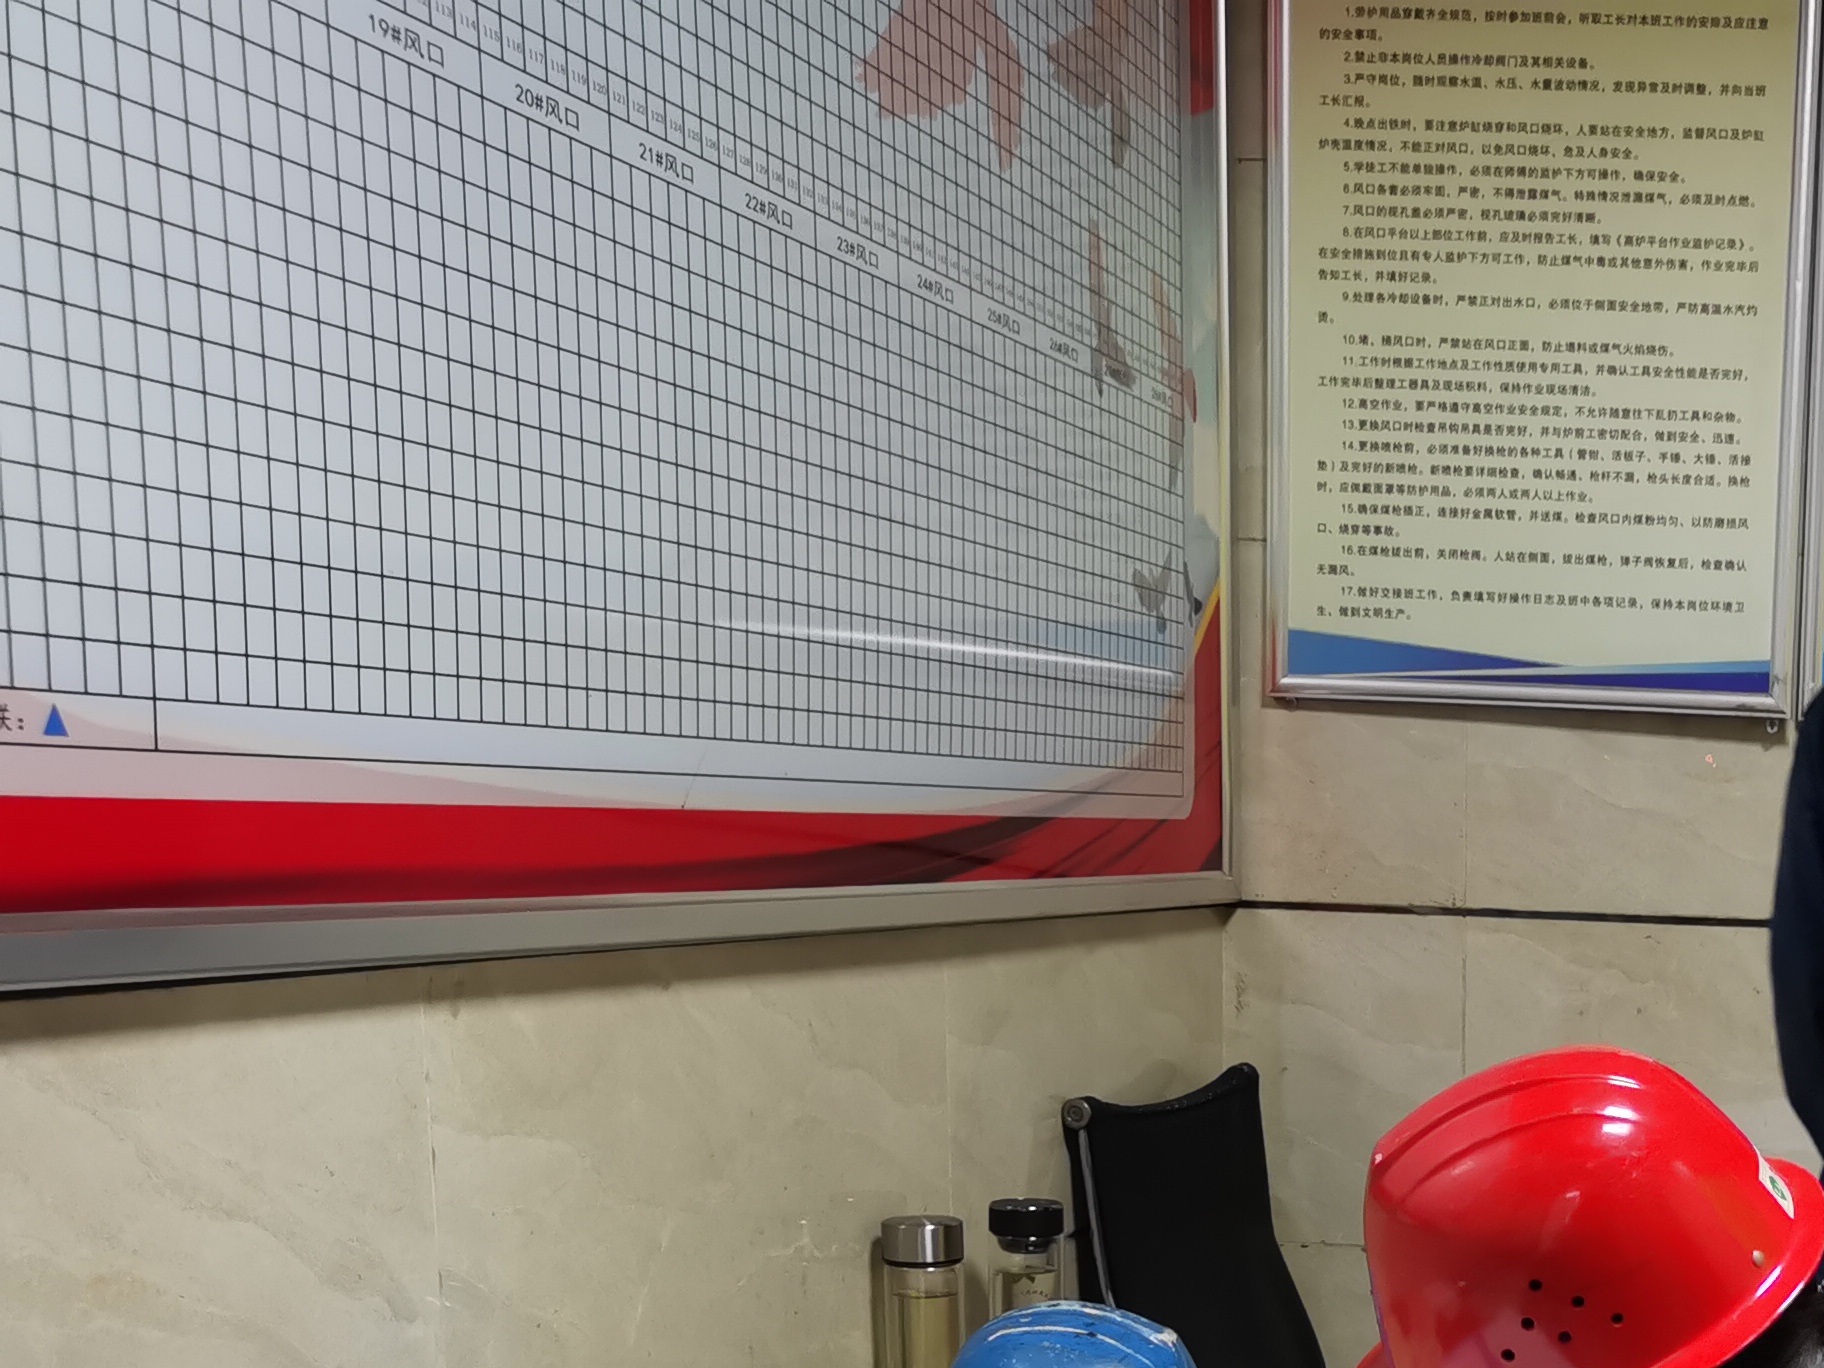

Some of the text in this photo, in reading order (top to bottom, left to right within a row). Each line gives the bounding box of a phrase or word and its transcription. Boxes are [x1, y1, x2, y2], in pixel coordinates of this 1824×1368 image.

[435, 0, 453, 19] 113
[459, 12, 477, 32] 114
[369, 13, 444, 68] 19#风口
[483, 24, 500, 43] 115
[506, 35, 523, 55] 116
[529, 47, 544, 65] 117
[550, 58, 566, 76] 118
[571, 68, 587, 87] 119
[592, 79, 608, 97] 120
[612, 89, 626, 106] 121
[515, 83, 580, 131] 20#风口
[632, 99, 646, 116] 122
[1319, 94, 1371, 108] 工长汇报。
[651, 109, 664, 125] 123
[669, 117, 683, 134] 124
[687, 127, 701, 143] 125
[638, 142, 694, 184] 21#风口
[744, 192, 793, 231] 22#风口
[836, 236, 879, 270] 23#风口
[916, 274, 954, 305] 24#风口
